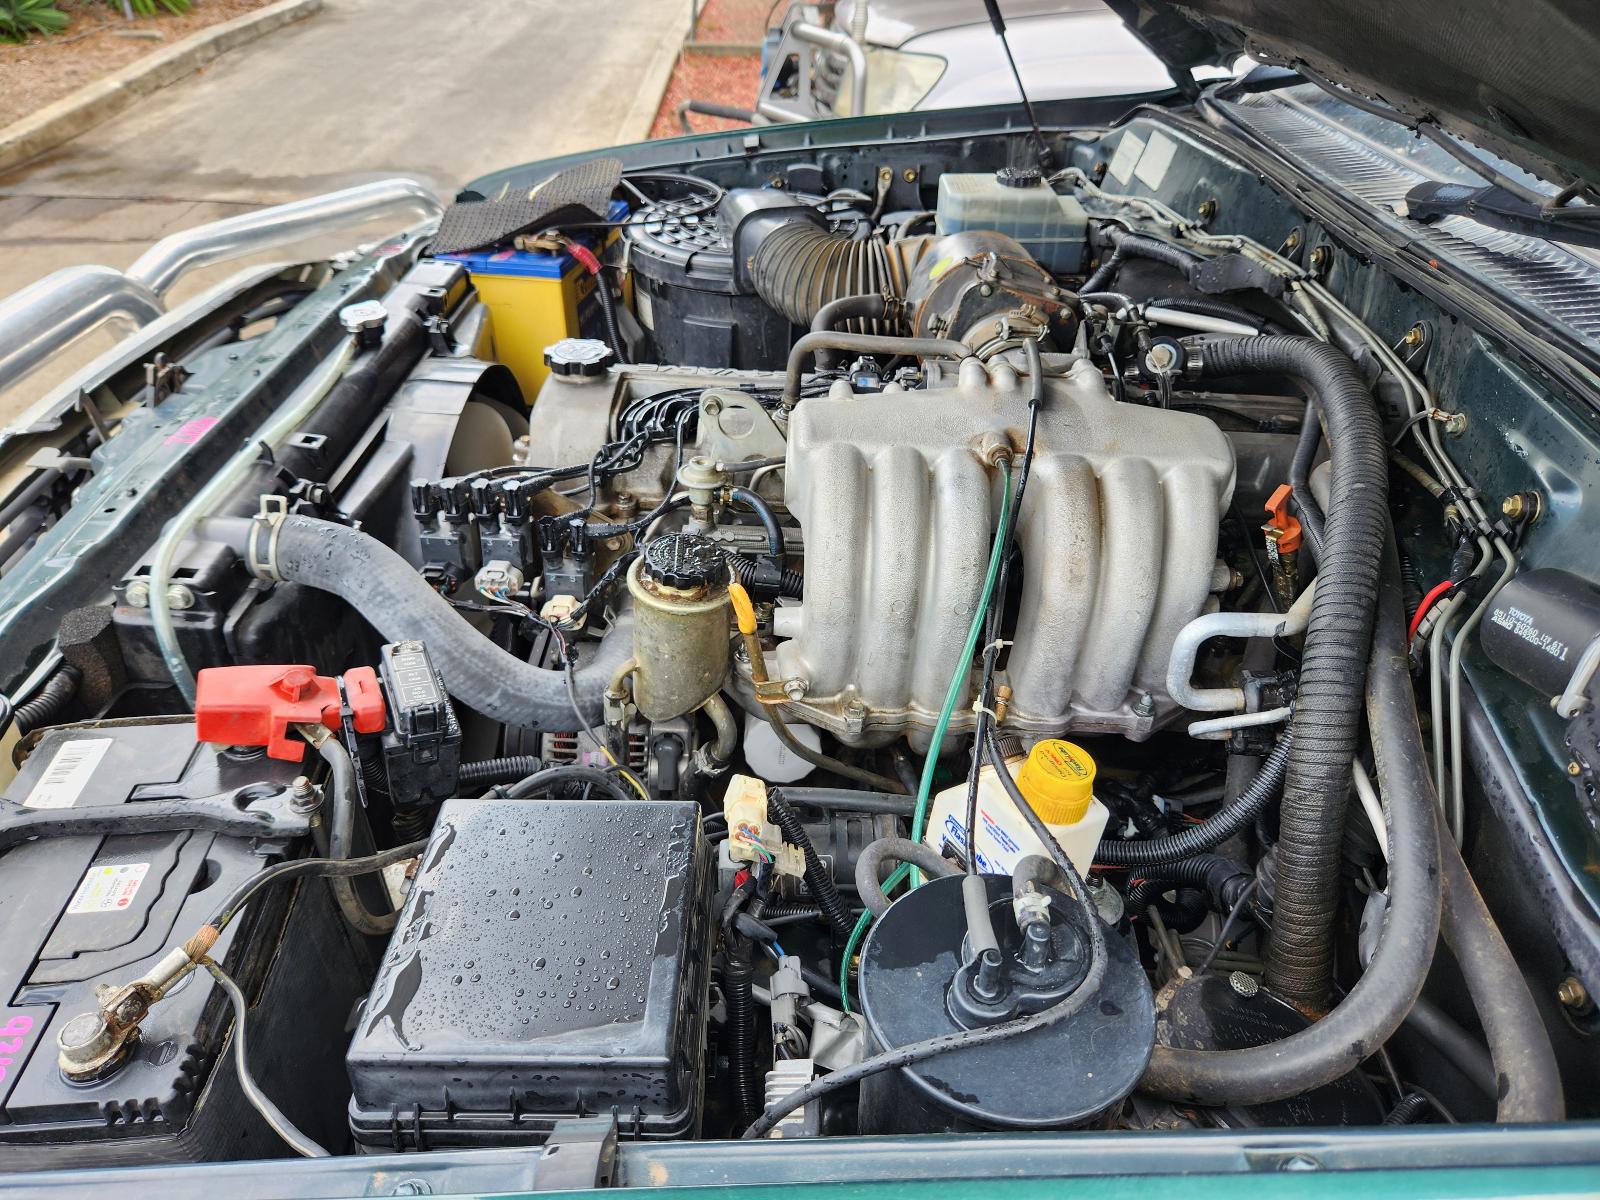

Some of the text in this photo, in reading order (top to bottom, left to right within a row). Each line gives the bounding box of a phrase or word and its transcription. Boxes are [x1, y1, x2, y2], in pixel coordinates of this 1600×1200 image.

[507, 540, 514, 548] 4
[1491, 615, 1513, 630] ASMO
[1508, 606, 1534, 625] TOYOTA
